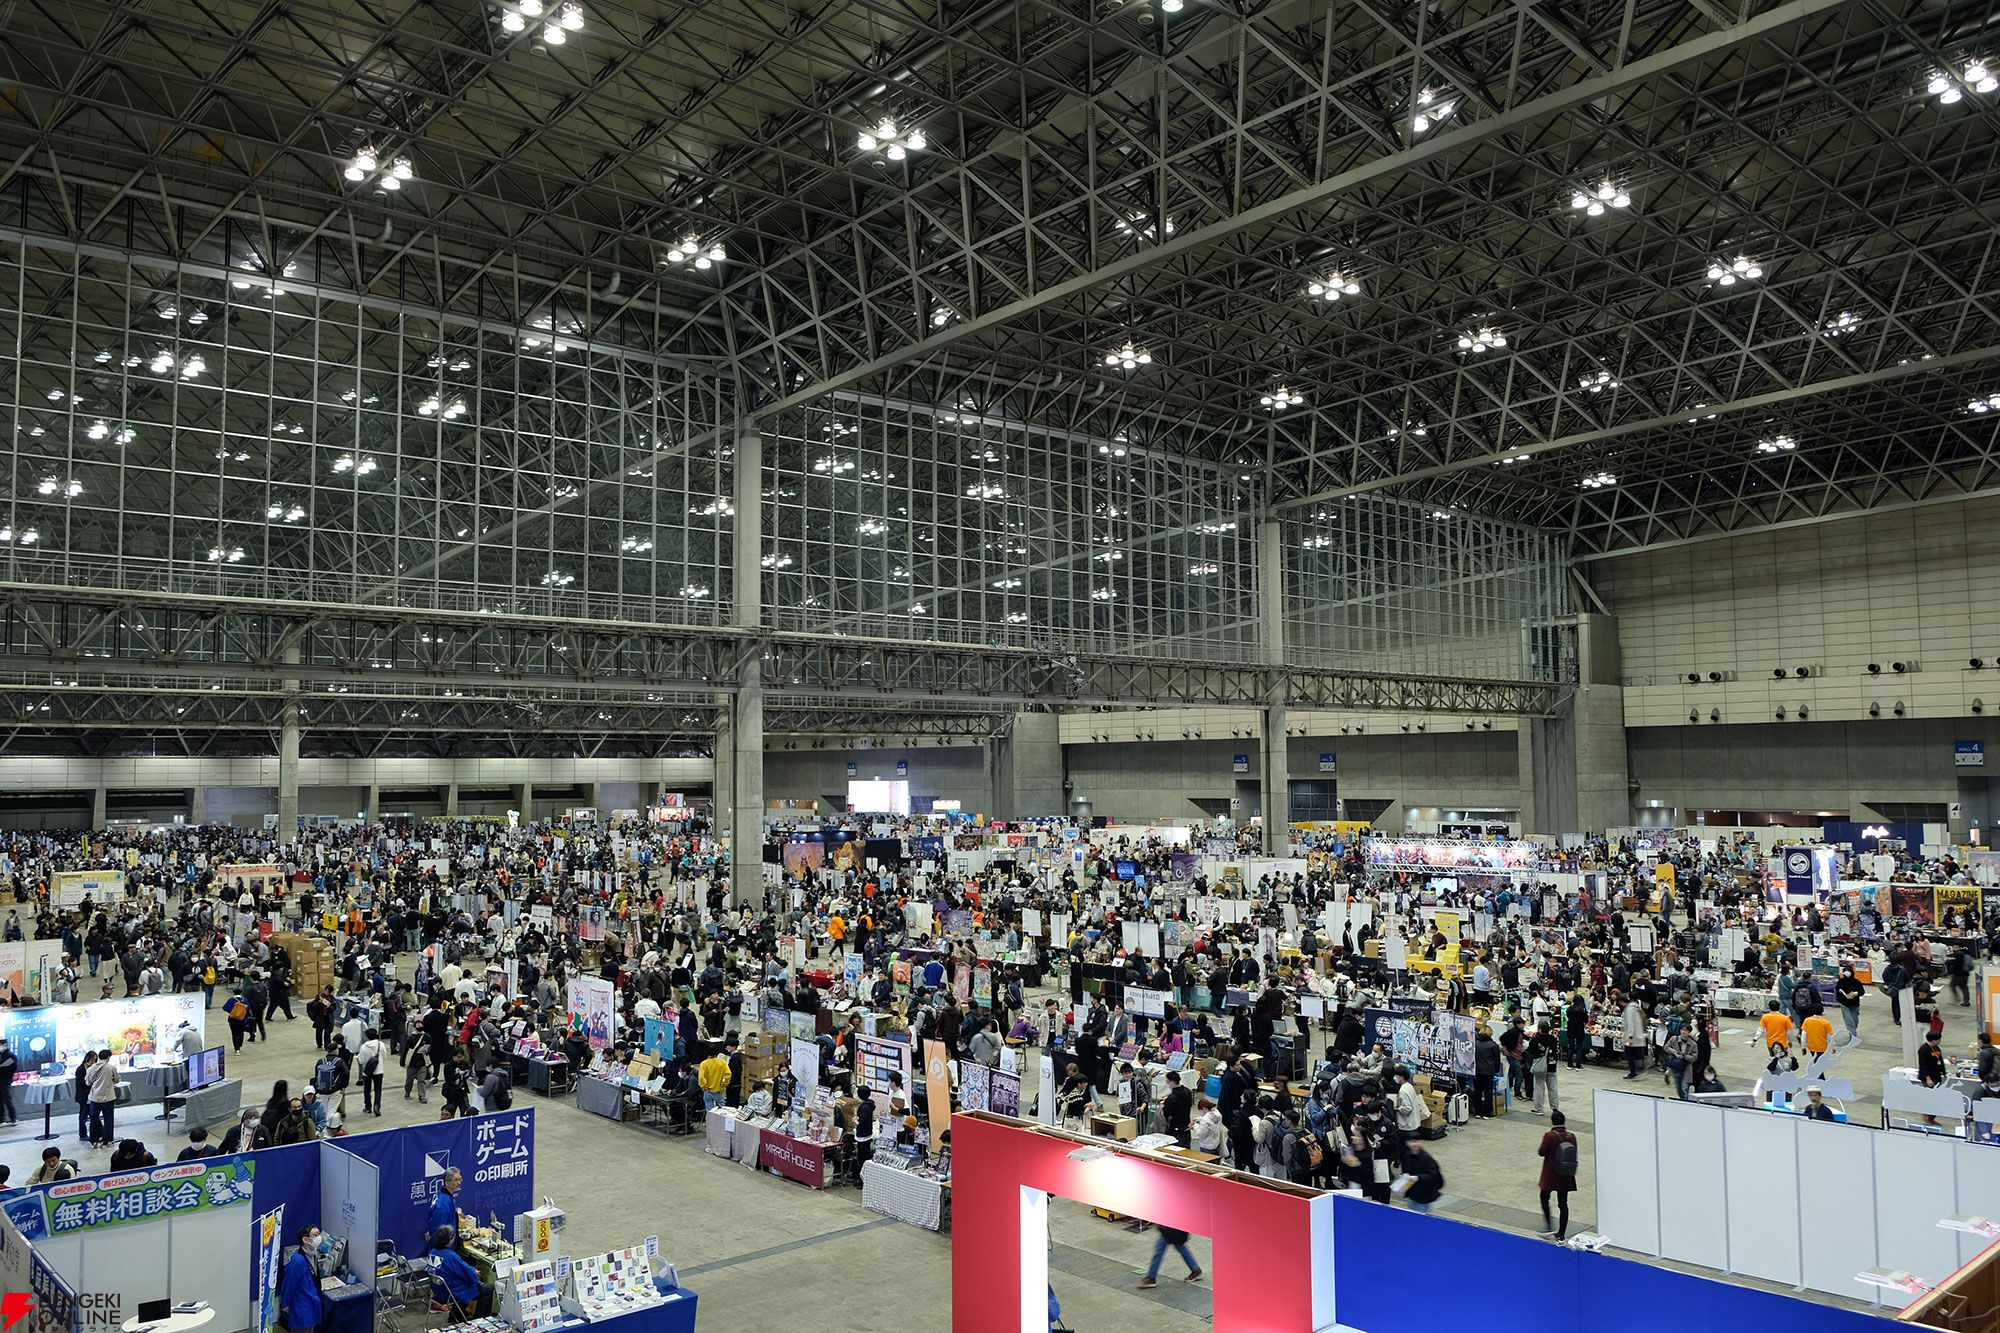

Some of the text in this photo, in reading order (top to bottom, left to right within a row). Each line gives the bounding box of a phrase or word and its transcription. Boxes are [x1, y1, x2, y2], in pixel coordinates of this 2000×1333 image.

[1972, 743, 1979, 752] 4
[1937, 889, 1979, 899] MAGAZINE
[476, 1114, 530, 1141] ボード
[475, 1138, 529, 1165] ゲーム
[764, 1142, 816, 1172] MIRROR HOUSE
[53, 1165, 203, 1196] 初心者歓迎 飛び込みOK サンプル展示中
[474, 1160, 528, 1183] の印刷所
[11, 1209, 41, 1223] ゲーム
[54, 1181, 201, 1230] 無料相談会
